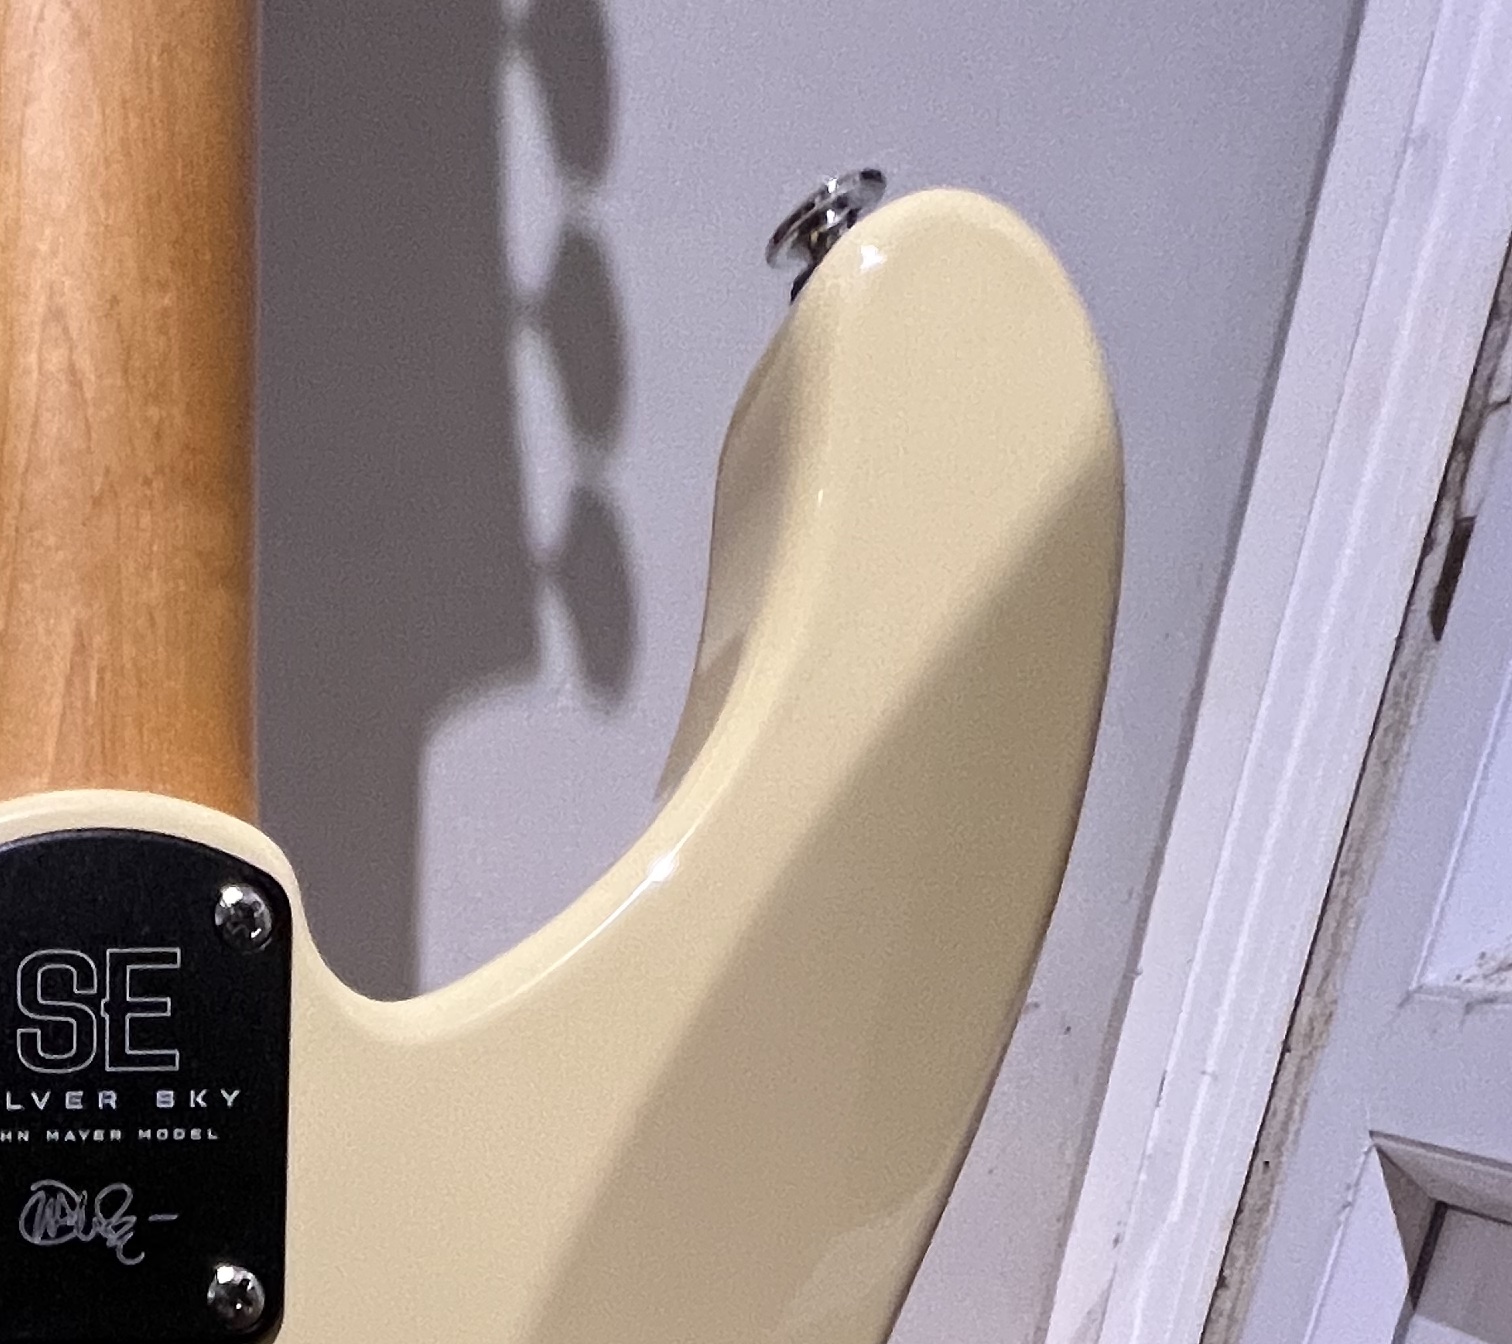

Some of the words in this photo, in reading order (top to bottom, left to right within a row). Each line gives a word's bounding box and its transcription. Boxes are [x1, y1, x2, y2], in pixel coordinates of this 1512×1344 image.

[15, 946, 182, 1075] SE
[156, 1088, 242, 1109] SKY
[46, 1128, 122, 1143] MAYER
[138, 1127, 218, 1142] MODEL
